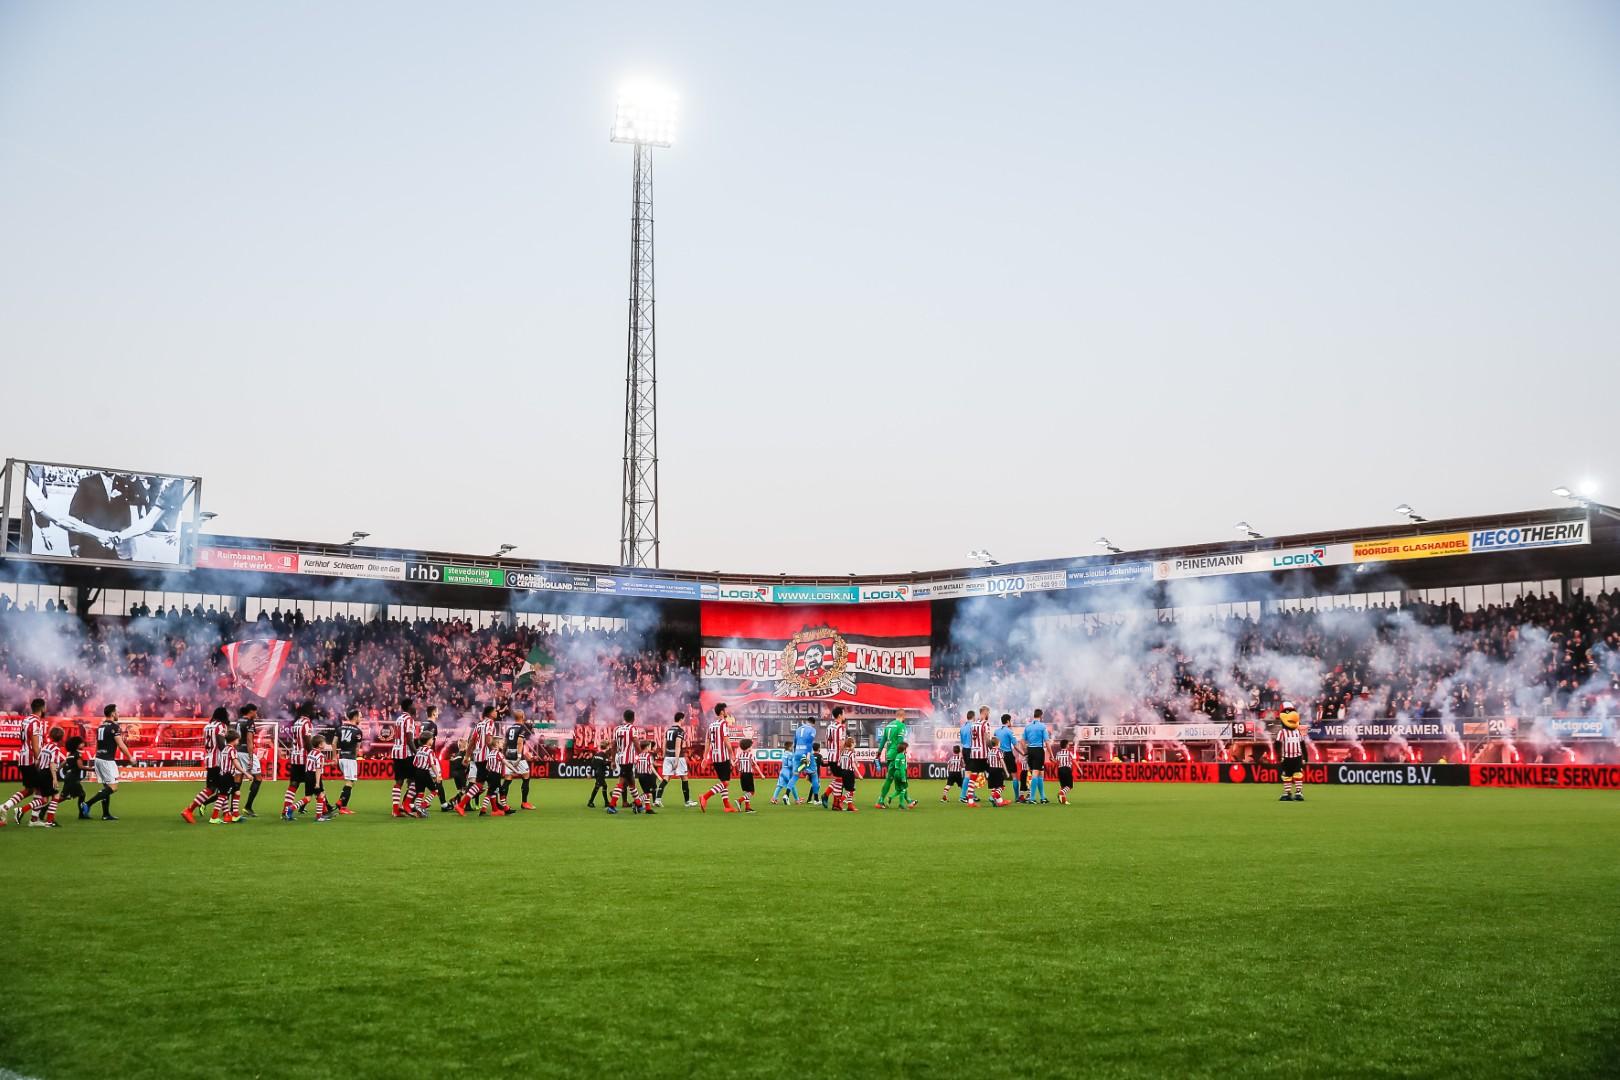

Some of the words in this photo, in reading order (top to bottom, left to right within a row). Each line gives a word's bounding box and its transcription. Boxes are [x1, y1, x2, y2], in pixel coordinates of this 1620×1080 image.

[1472, 523, 1583, 547] HECOTHERM
[1354, 546, 1400, 556] NOORDER
[1402, 540, 1468, 552] GLASHANDEL
[217, 551, 265, 561] Ruimbaan.nl
[1175, 555, 1243, 570] PEINEMANN
[1273, 552, 1322, 566] LOGIX
[333, 562, 364, 570] Schiedam
[410, 565, 440, 580] rhb
[448, 568, 489, 578] stevedoring
[448, 575, 493, 585] warehousing
[517, 574, 547, 583] Mobility
[987, 578, 1025, 592] DOZO
[720, 588, 762, 601] LOGIX
[777, 592, 856, 600] WWW.LOGIX.NL
[863, 588, 905, 601] LOGIX
[704, 650, 777, 677] SPANGE
[856, 648, 915, 676] NAREN
[1233, 724, 1244, 734] 19
[1325, 725, 1458, 735] WERKENBIJKRAMER.NL
[1489, 720, 1505, 731] 20
[1077, 766, 1122, 780] SERVICES
[1126, 765, 1187, 781] EUROPOORT
[1190, 766, 1211, 781] B.V.
[1251, 765, 1278, 782] Van
[1338, 766, 1403, 783] Concerns
[1407, 767, 1436, 784] B.V.
[1480, 767, 1559, 784] SPRINKLER
